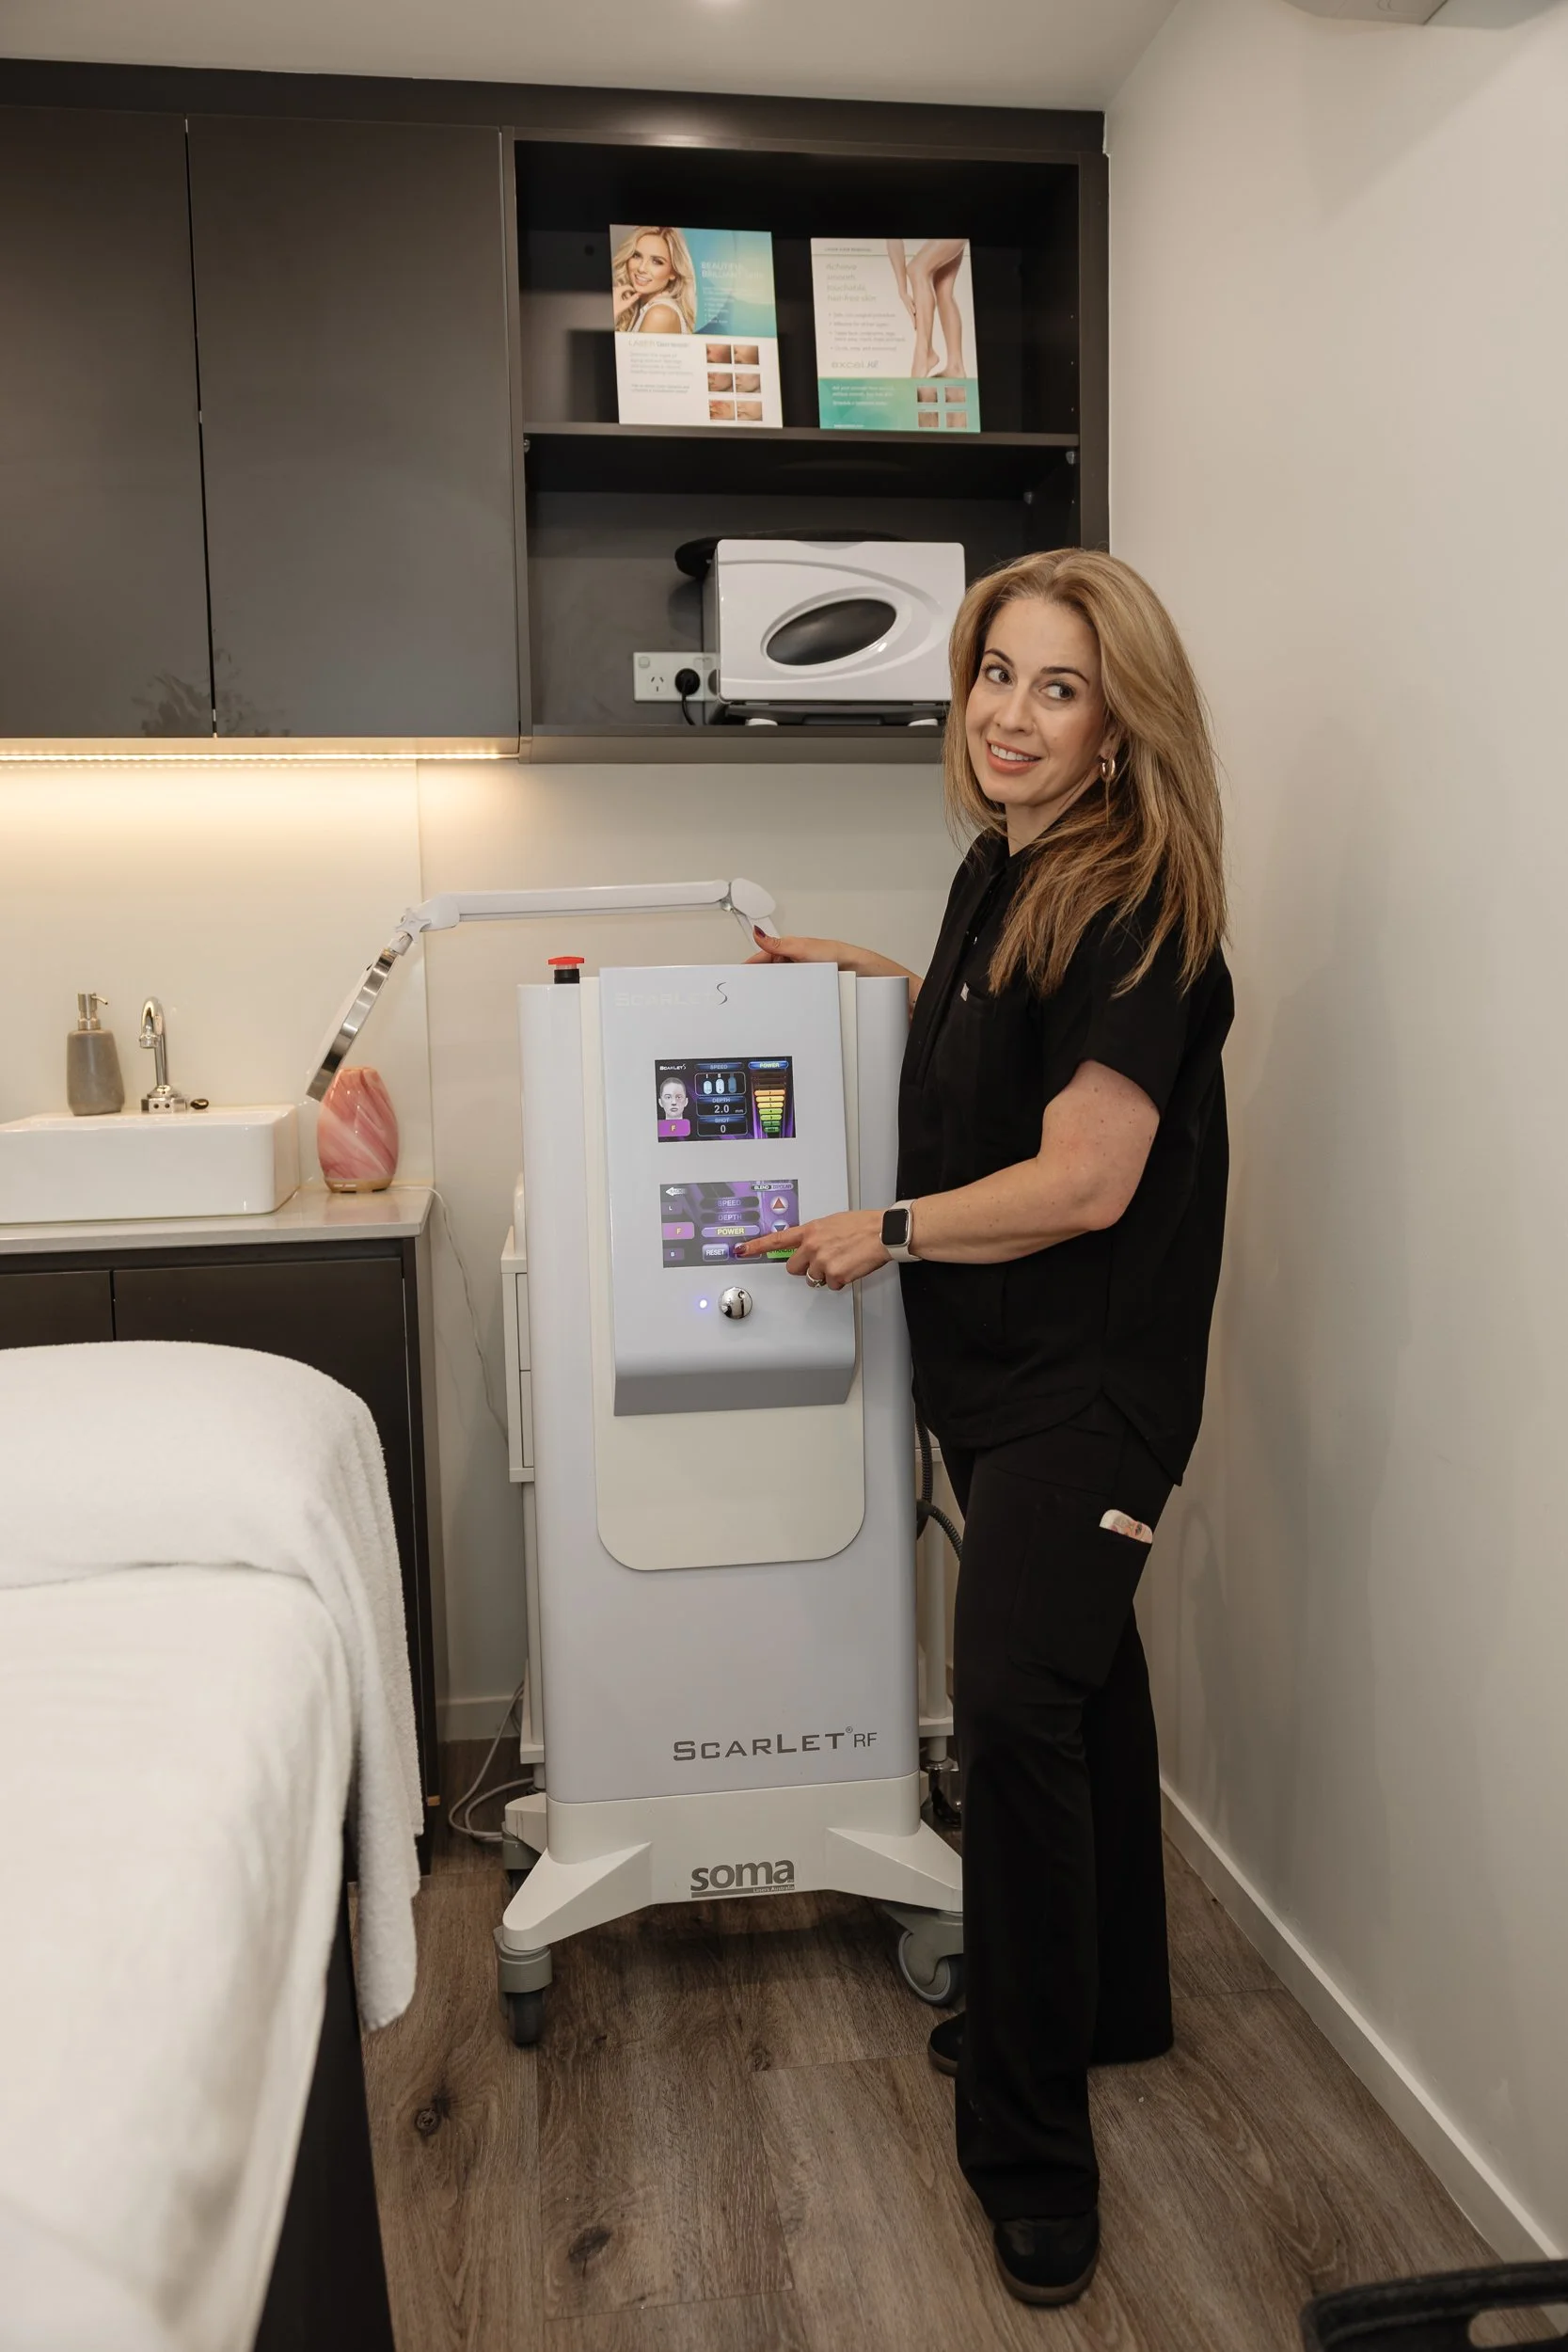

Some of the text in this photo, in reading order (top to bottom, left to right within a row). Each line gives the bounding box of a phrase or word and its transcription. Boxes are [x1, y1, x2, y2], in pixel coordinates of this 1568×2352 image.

[714, 1104, 730, 1114] 2.0
[720, 1124, 726, 1133] 0
[854, 1732, 878, 1748] RF
[690, 1859, 795, 1891] soma
